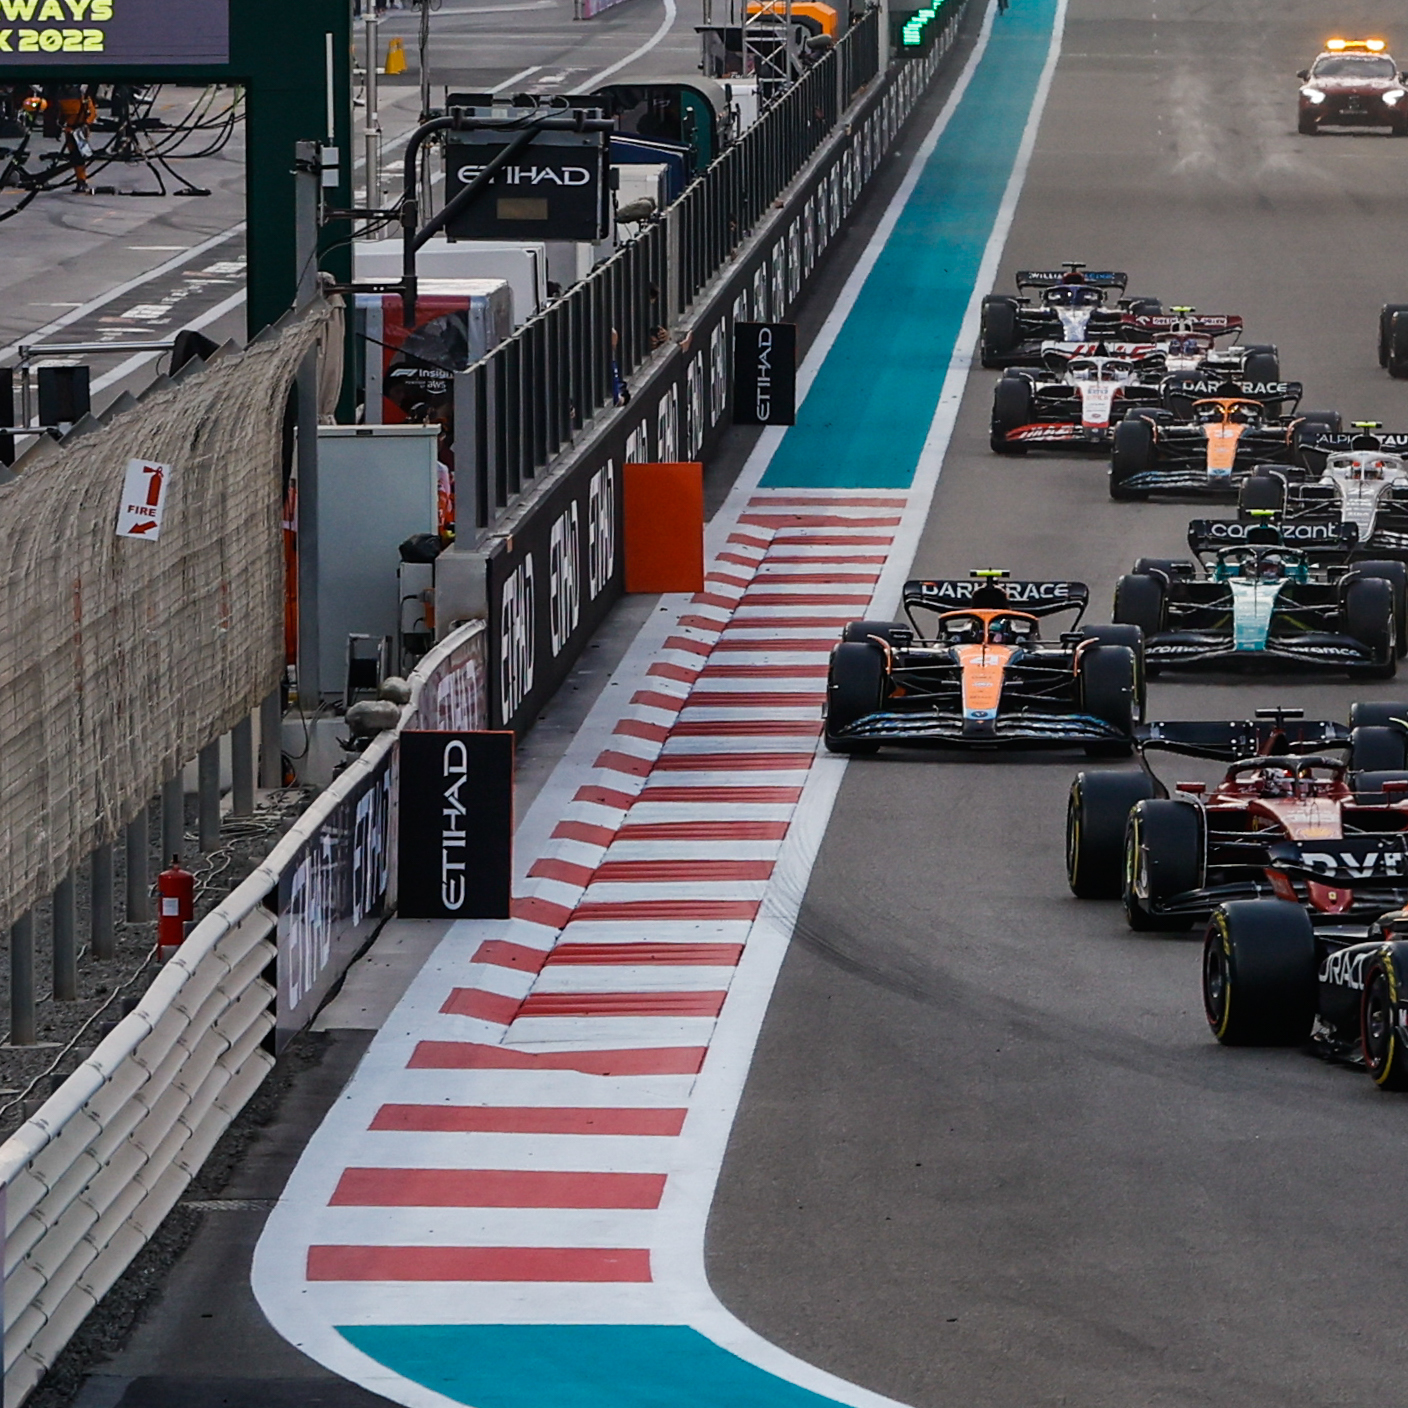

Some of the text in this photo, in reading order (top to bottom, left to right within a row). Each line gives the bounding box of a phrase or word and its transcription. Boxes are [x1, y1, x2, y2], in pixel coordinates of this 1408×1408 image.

[17, 28, 105, 53] 2022
[457, 164, 591, 187] EIHAD
[755, 327, 773, 423] ETIHAD
[126, 504, 158, 517] FIRE
[921, 581, 1070, 599] DARKRACE
[441, 739, 469, 912] ETIHAD
